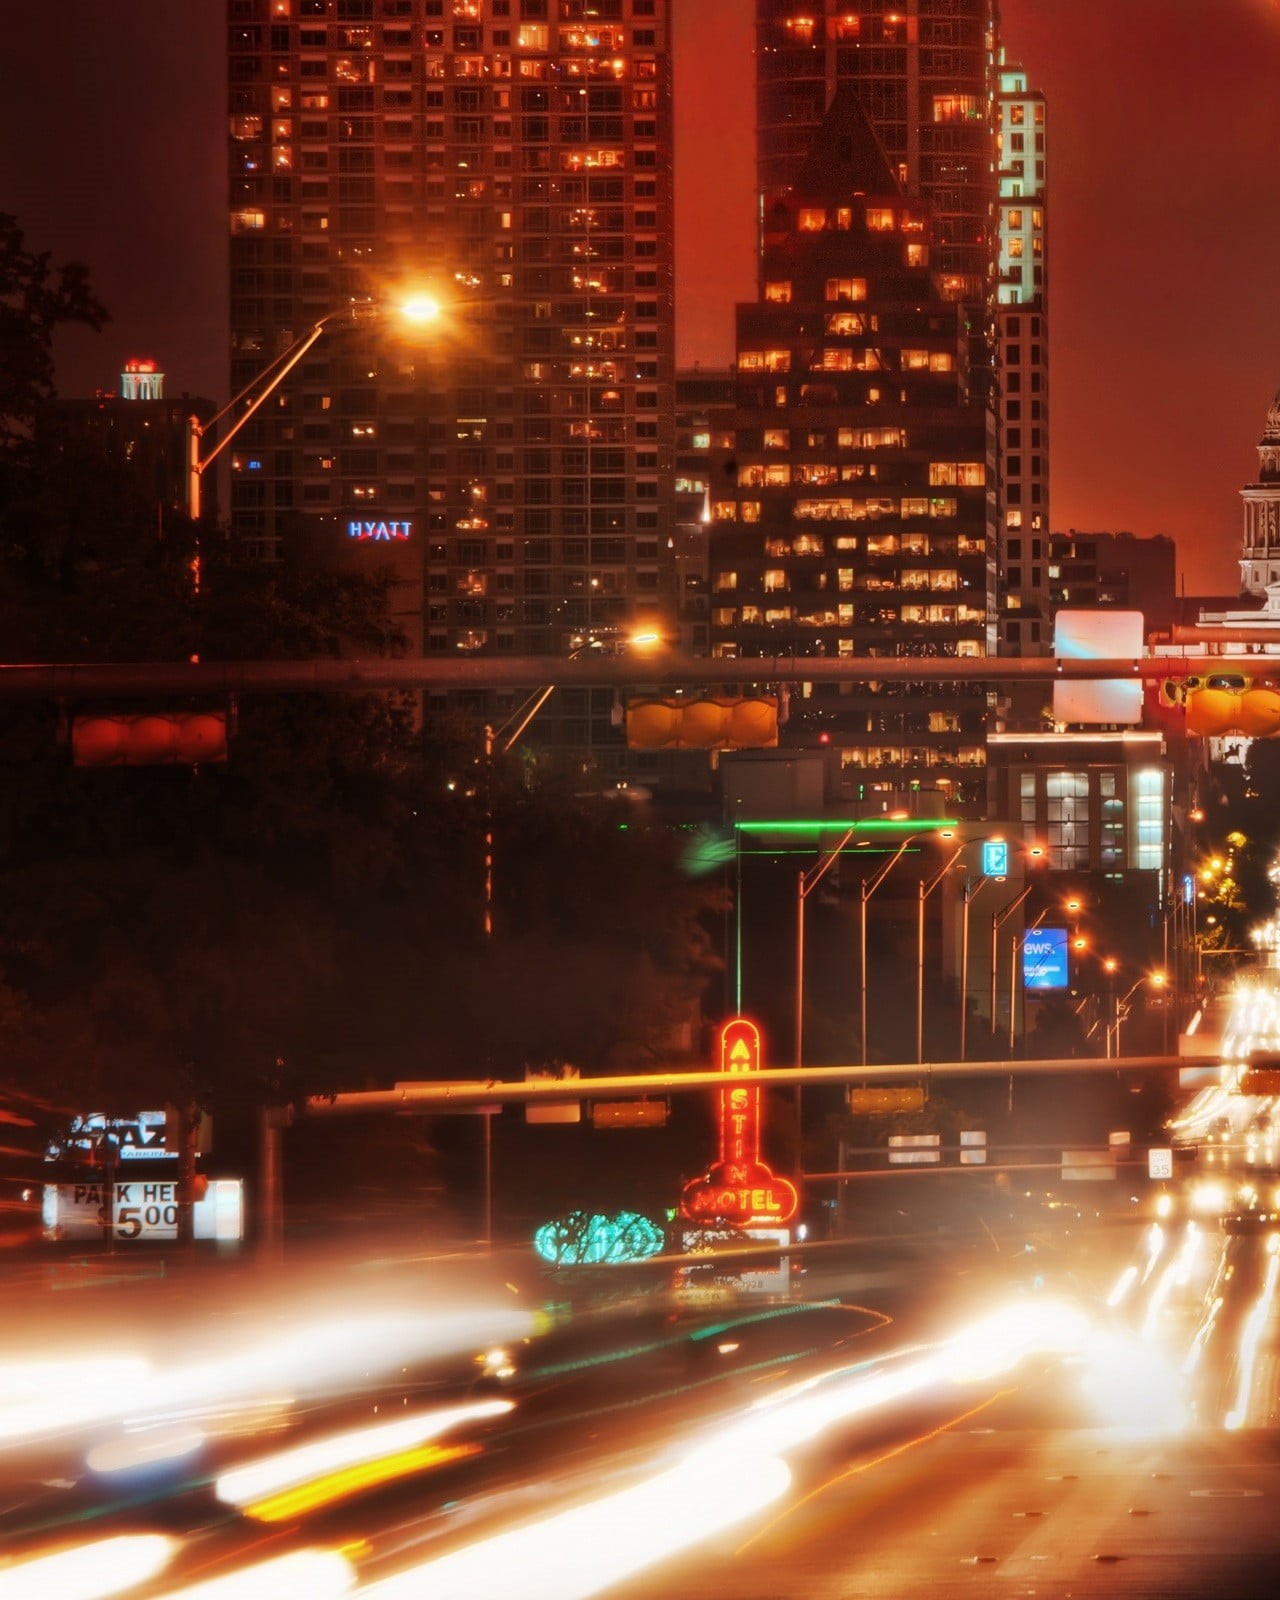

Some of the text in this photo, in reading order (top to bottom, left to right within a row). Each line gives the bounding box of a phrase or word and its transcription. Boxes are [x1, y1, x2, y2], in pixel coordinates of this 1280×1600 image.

[348, 521, 412, 540] HYATT
[1152, 1164, 1169, 1176] 35
[74, 1184, 178, 1204] PAK HE
[694, 1189, 781, 1211] MOTEL
